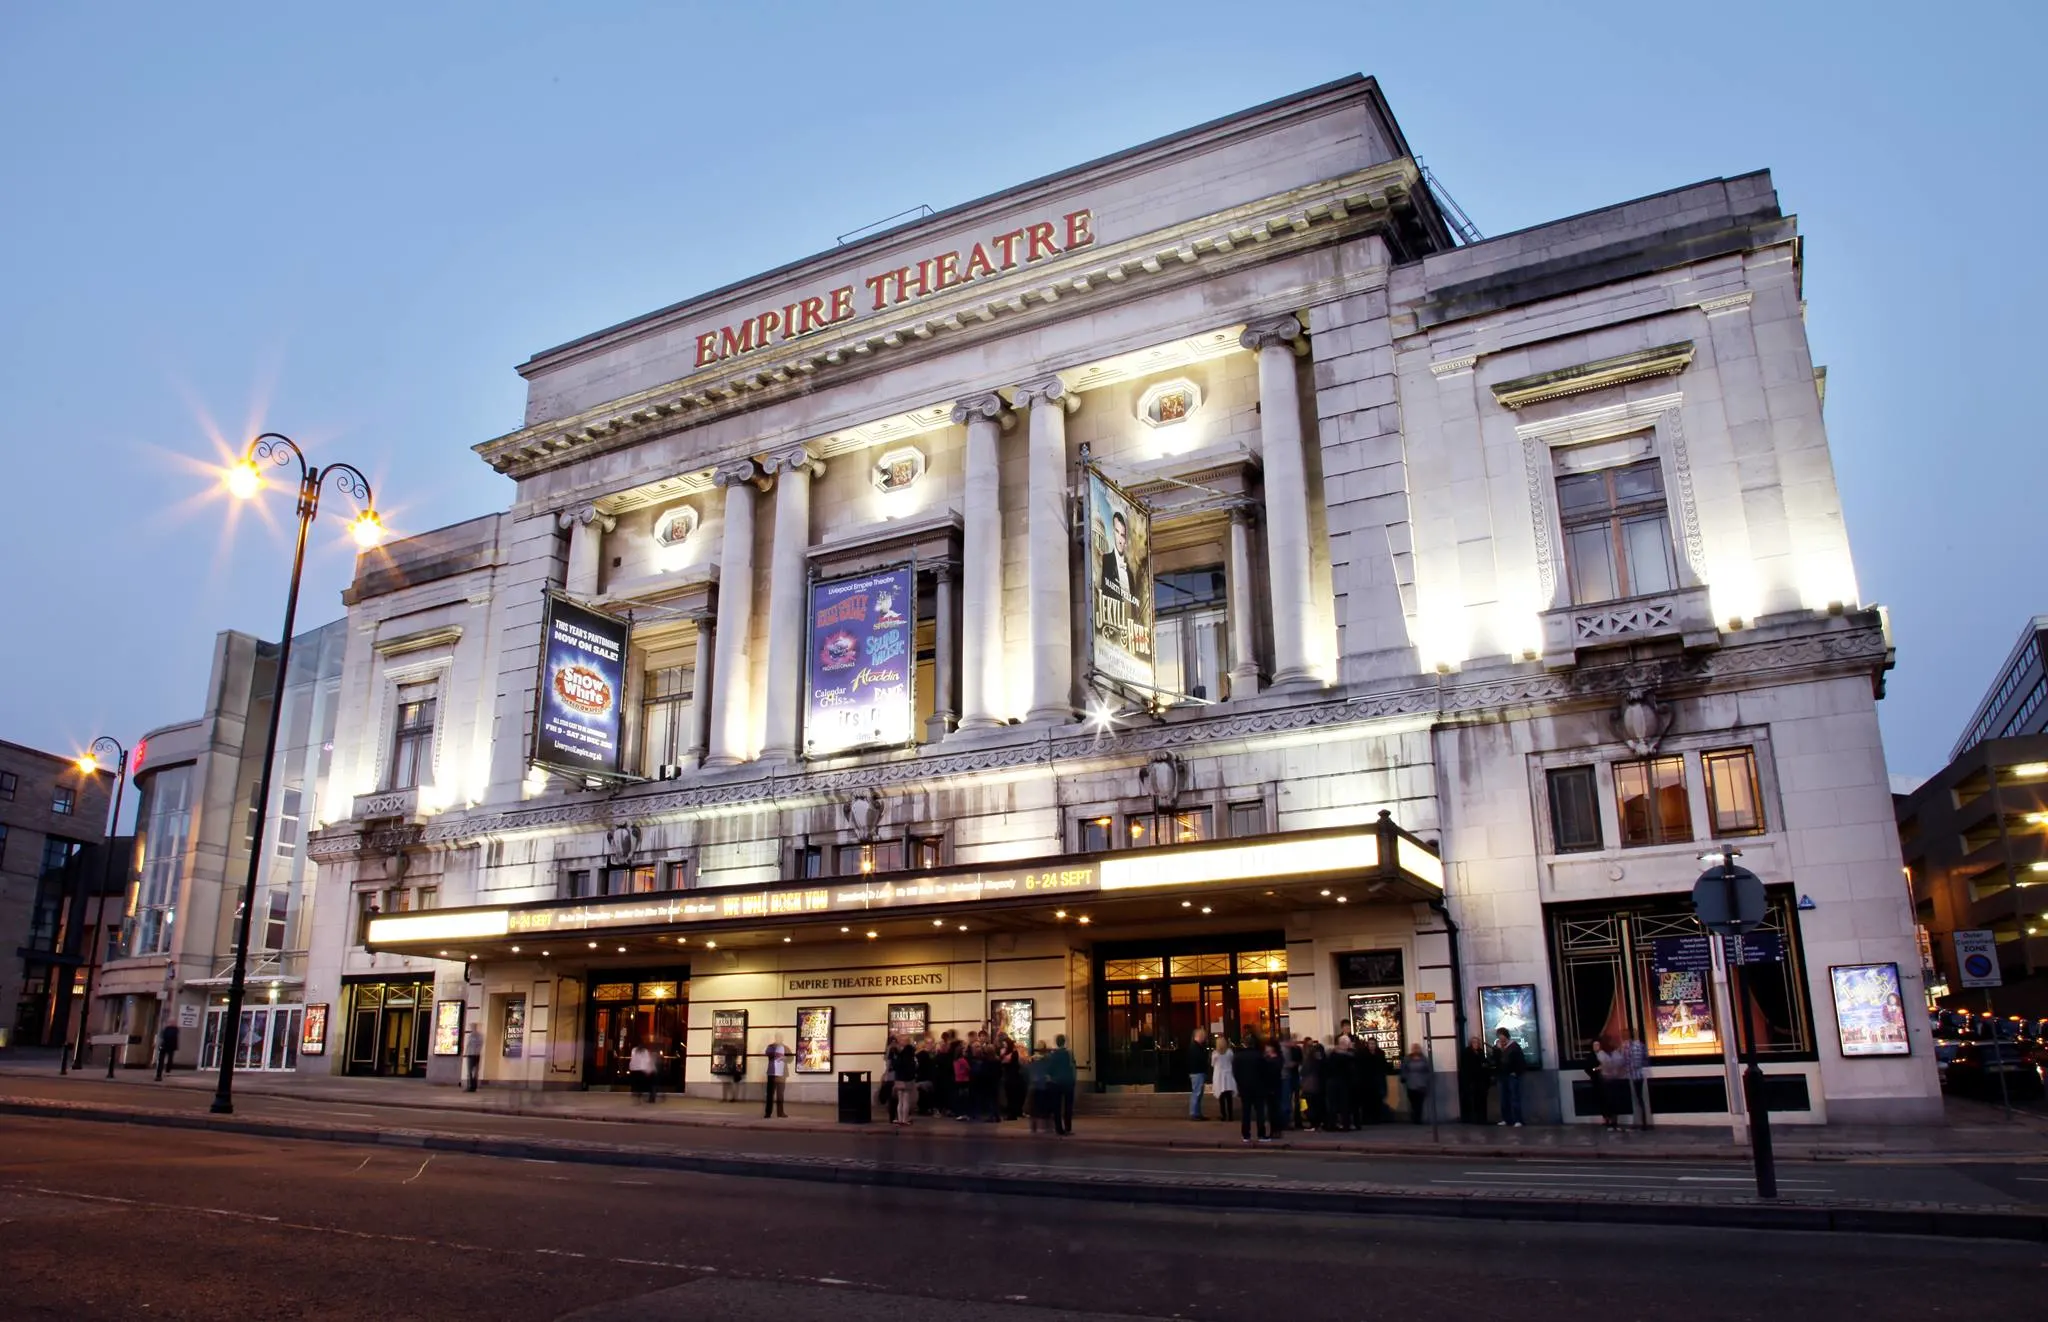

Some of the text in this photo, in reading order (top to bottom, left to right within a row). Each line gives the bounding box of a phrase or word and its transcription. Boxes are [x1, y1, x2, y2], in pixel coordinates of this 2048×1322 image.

[695, 208, 1096, 367] EMPIRE THEATRE
[828, 584, 853, 595] Liverpool
[853, 581, 873, 590] Empire
[873, 577, 895, 586] Theatre
[1096, 588, 1127, 629] JEKYLL
[554, 631, 618, 662] NOW ON SALE!
[555, 619, 620, 652] THIS YEAR'S PANTOMIME
[564, 667, 604, 691] Snow
[850, 667, 900, 692] Aladdin
[564, 680, 604, 705] White
[815, 687, 847, 698] Calendar
[1060, 869, 1092, 886] SEPT
[789, 973, 943, 990] EMPIRE THEATRE PRESENTS
